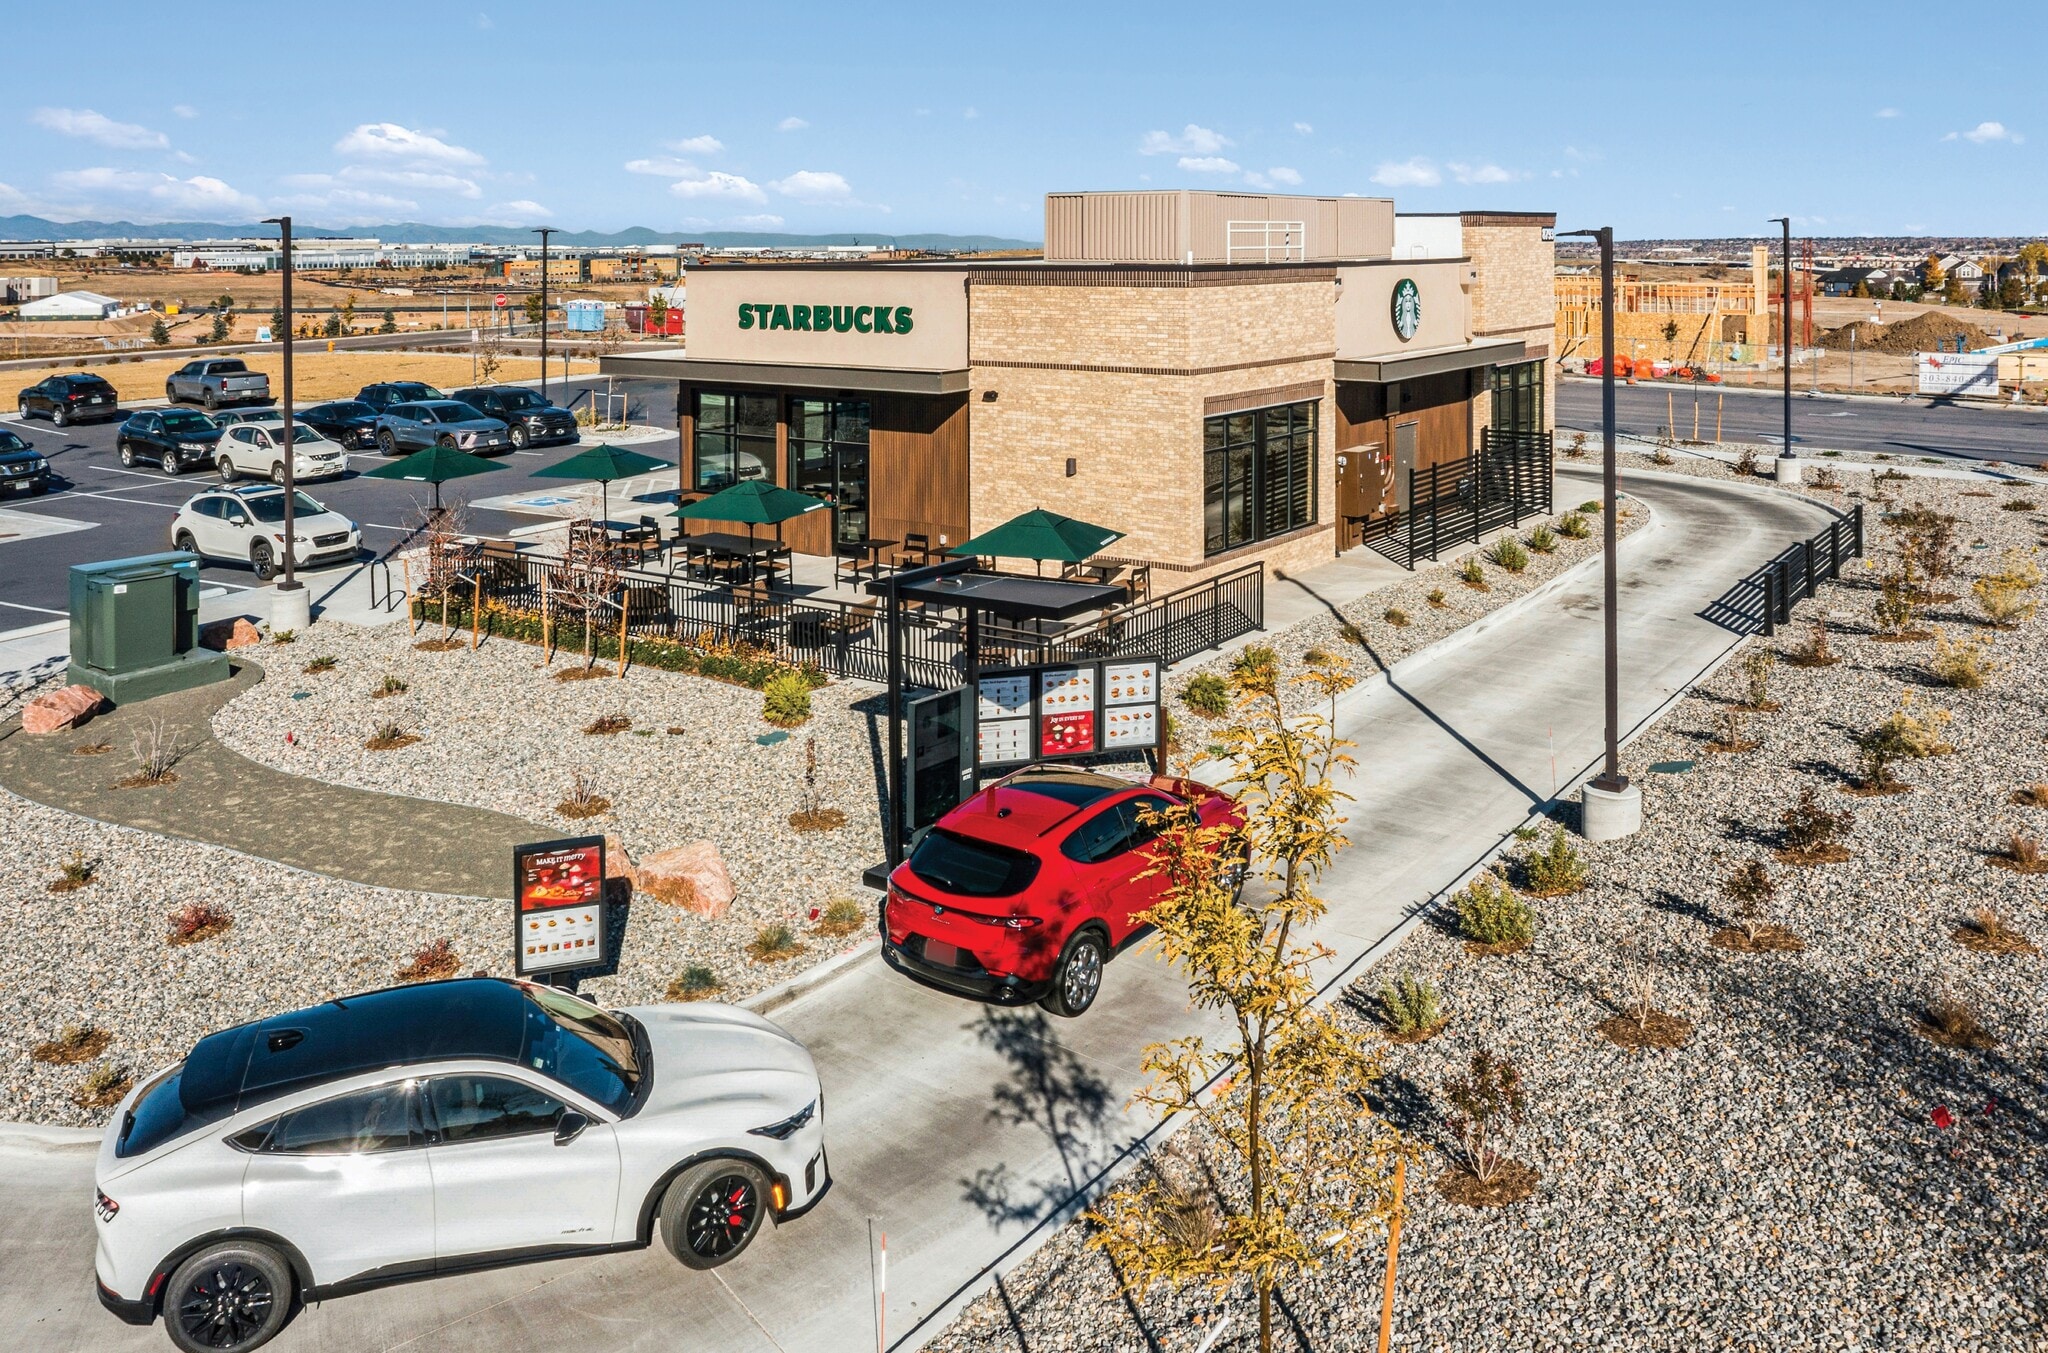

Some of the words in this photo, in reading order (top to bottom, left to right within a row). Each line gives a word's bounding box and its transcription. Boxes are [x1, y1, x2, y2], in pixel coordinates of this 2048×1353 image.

[738, 303, 914, 335] STARBUCKS
[1943, 355, 1964, 363] EPIC
[536, 857, 555, 866] MAKE
[563, 853, 586, 863] merry
